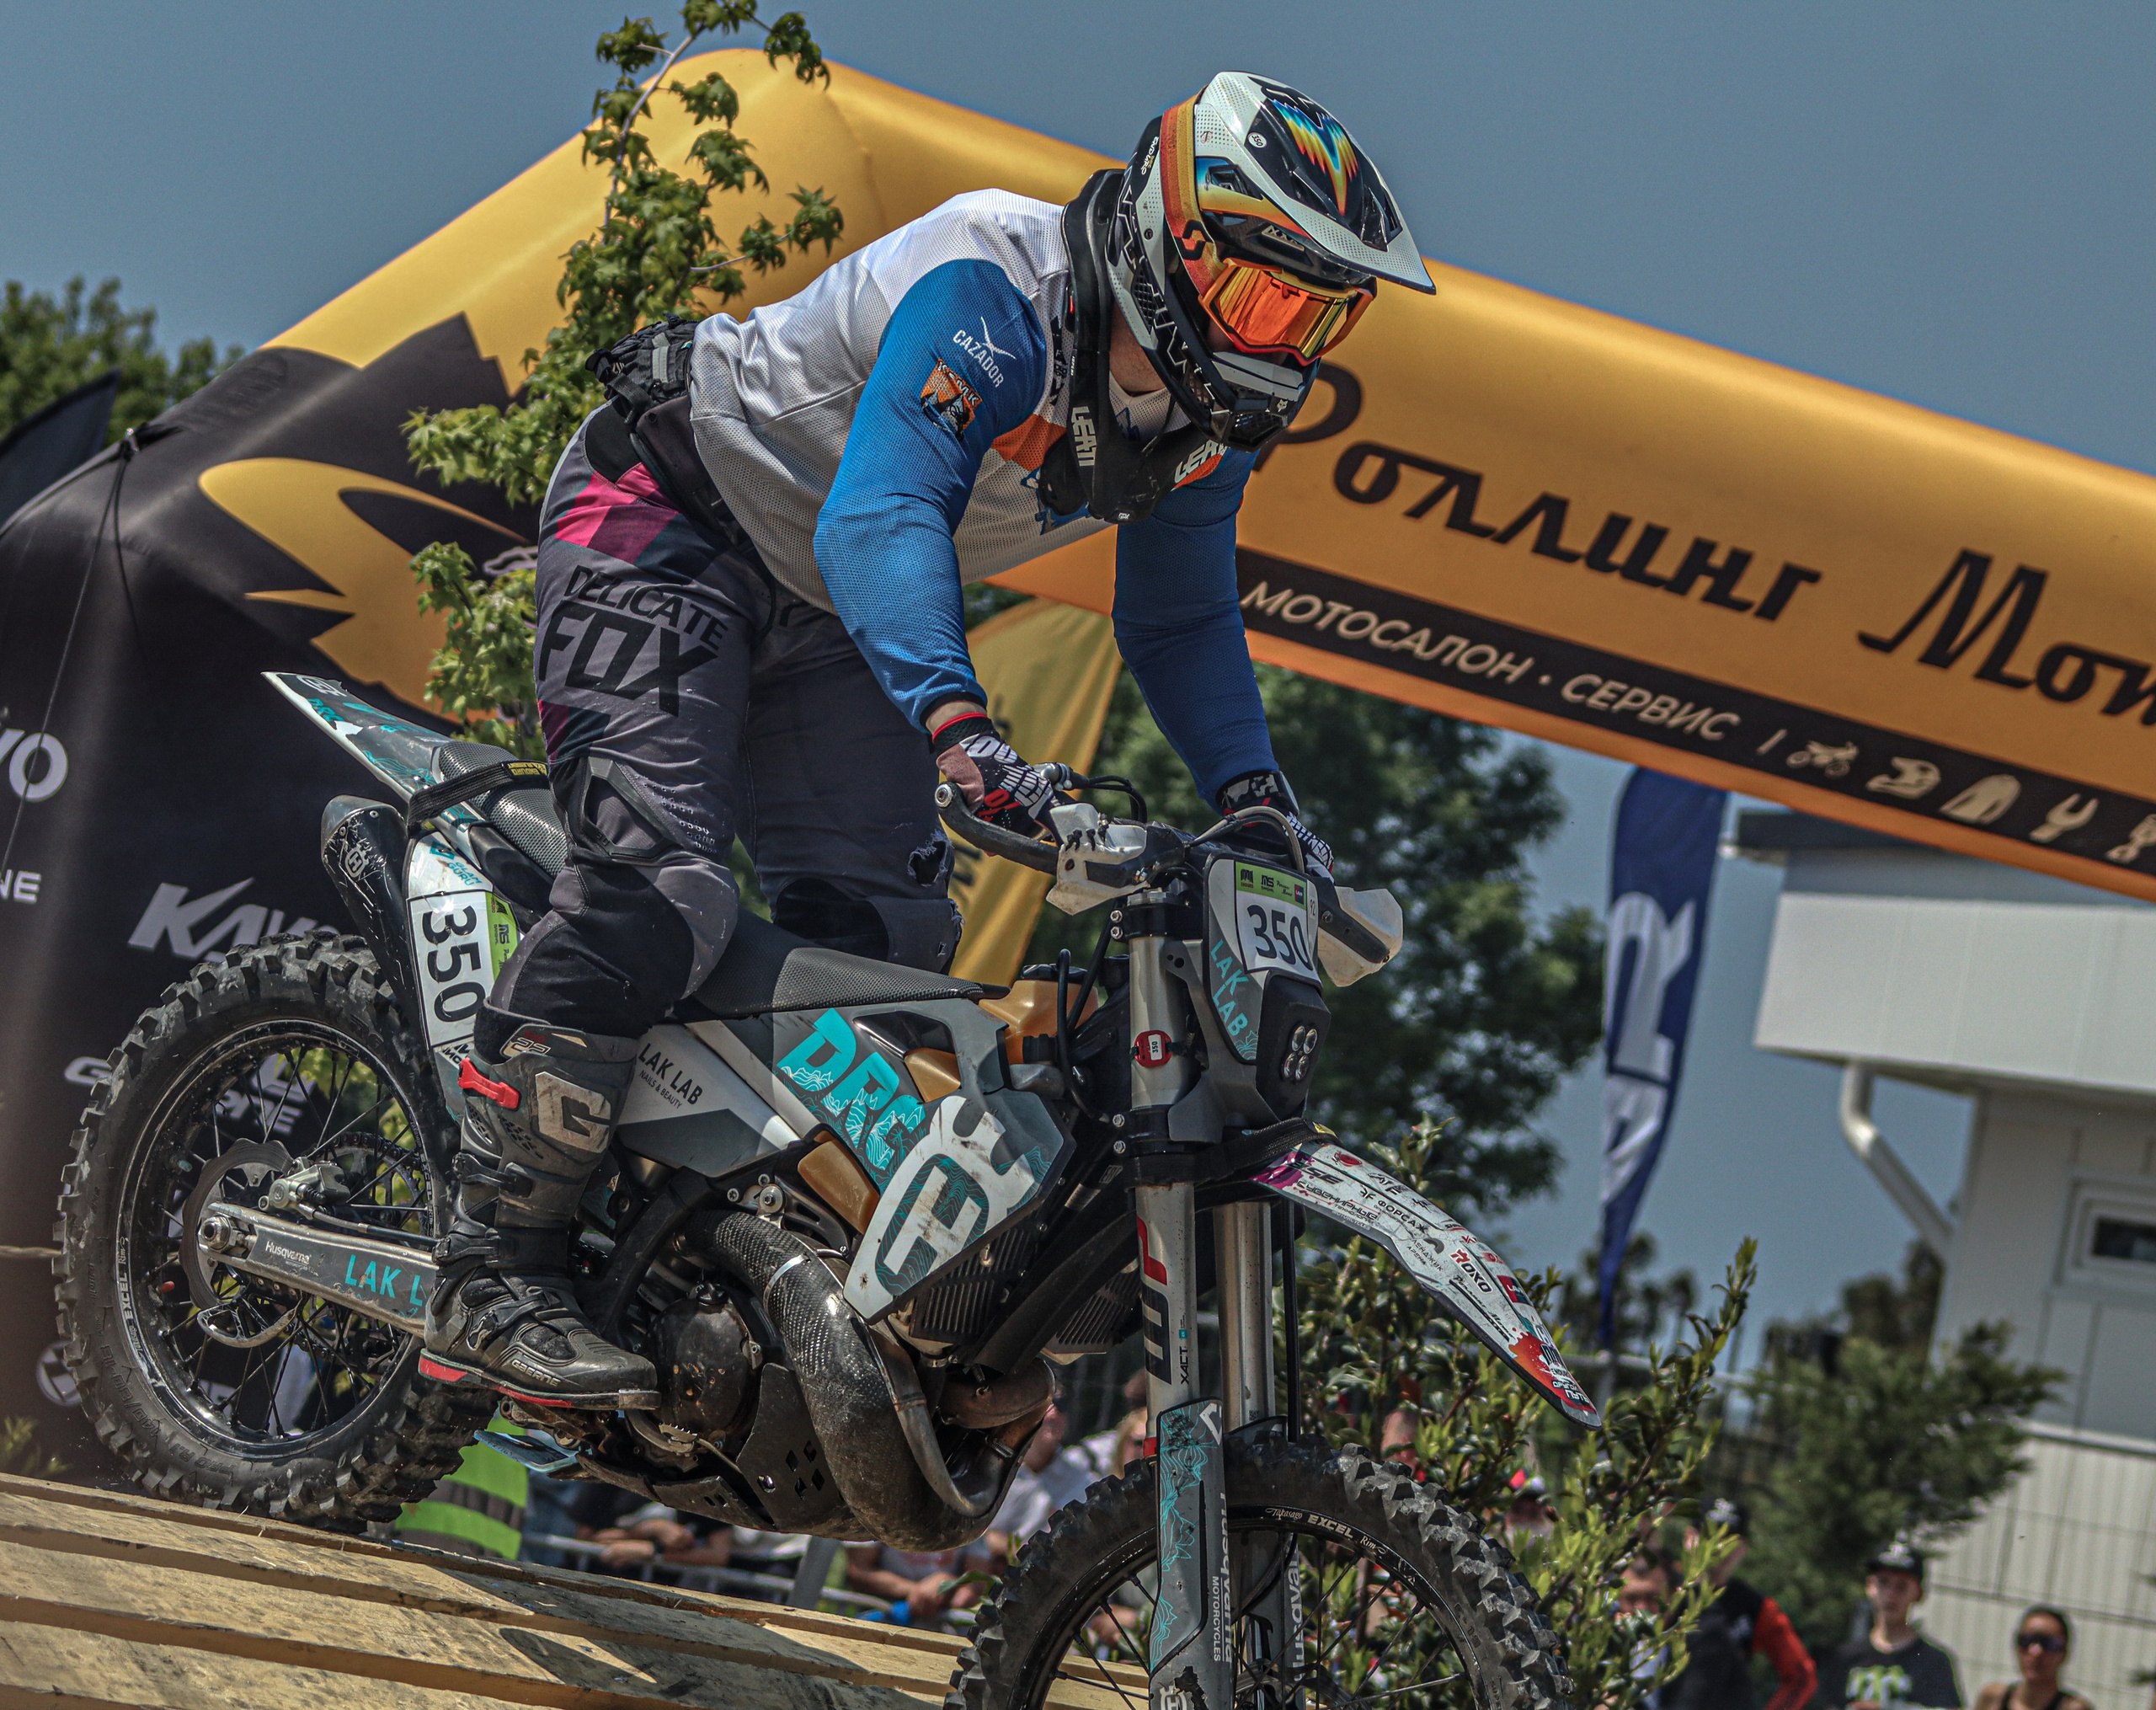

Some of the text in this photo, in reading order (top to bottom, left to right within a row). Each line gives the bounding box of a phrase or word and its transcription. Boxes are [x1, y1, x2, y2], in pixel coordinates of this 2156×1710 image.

[1251, 133, 1264, 147] 350
[953, 329, 1004, 388] CAZADOR
[566, 564, 729, 652] DELICATE
[539, 599, 718, 718] FOX
[1241, 580, 1742, 740] МОТОСАЛОН СЕРВИС
[447, 863, 475, 886] GURU
[422, 905, 486, 1023] 350
[1246, 905, 1313, 970] 350
[1210, 939, 1249, 996] LAK
[1213, 983, 1248, 1036] LAB
[638, 1043, 702, 1104] LAK LAB
[639, 1070, 657, 1087] NAILS
[660, 1087, 682, 1109] BEAUTY
[1377, 1199, 1429, 1234] ФОРСАЖ
[121, 1272, 134, 1320] EXCEL
[344, 1254, 402, 1299] LAK
[1449, 1248, 1493, 1294] ROXO
[1180, 1346, 1190, 1386] XACT
[1306, 1514, 1353, 1540] EXCEL
[1211, 1575, 1221, 1663] MOTORCYCLES
